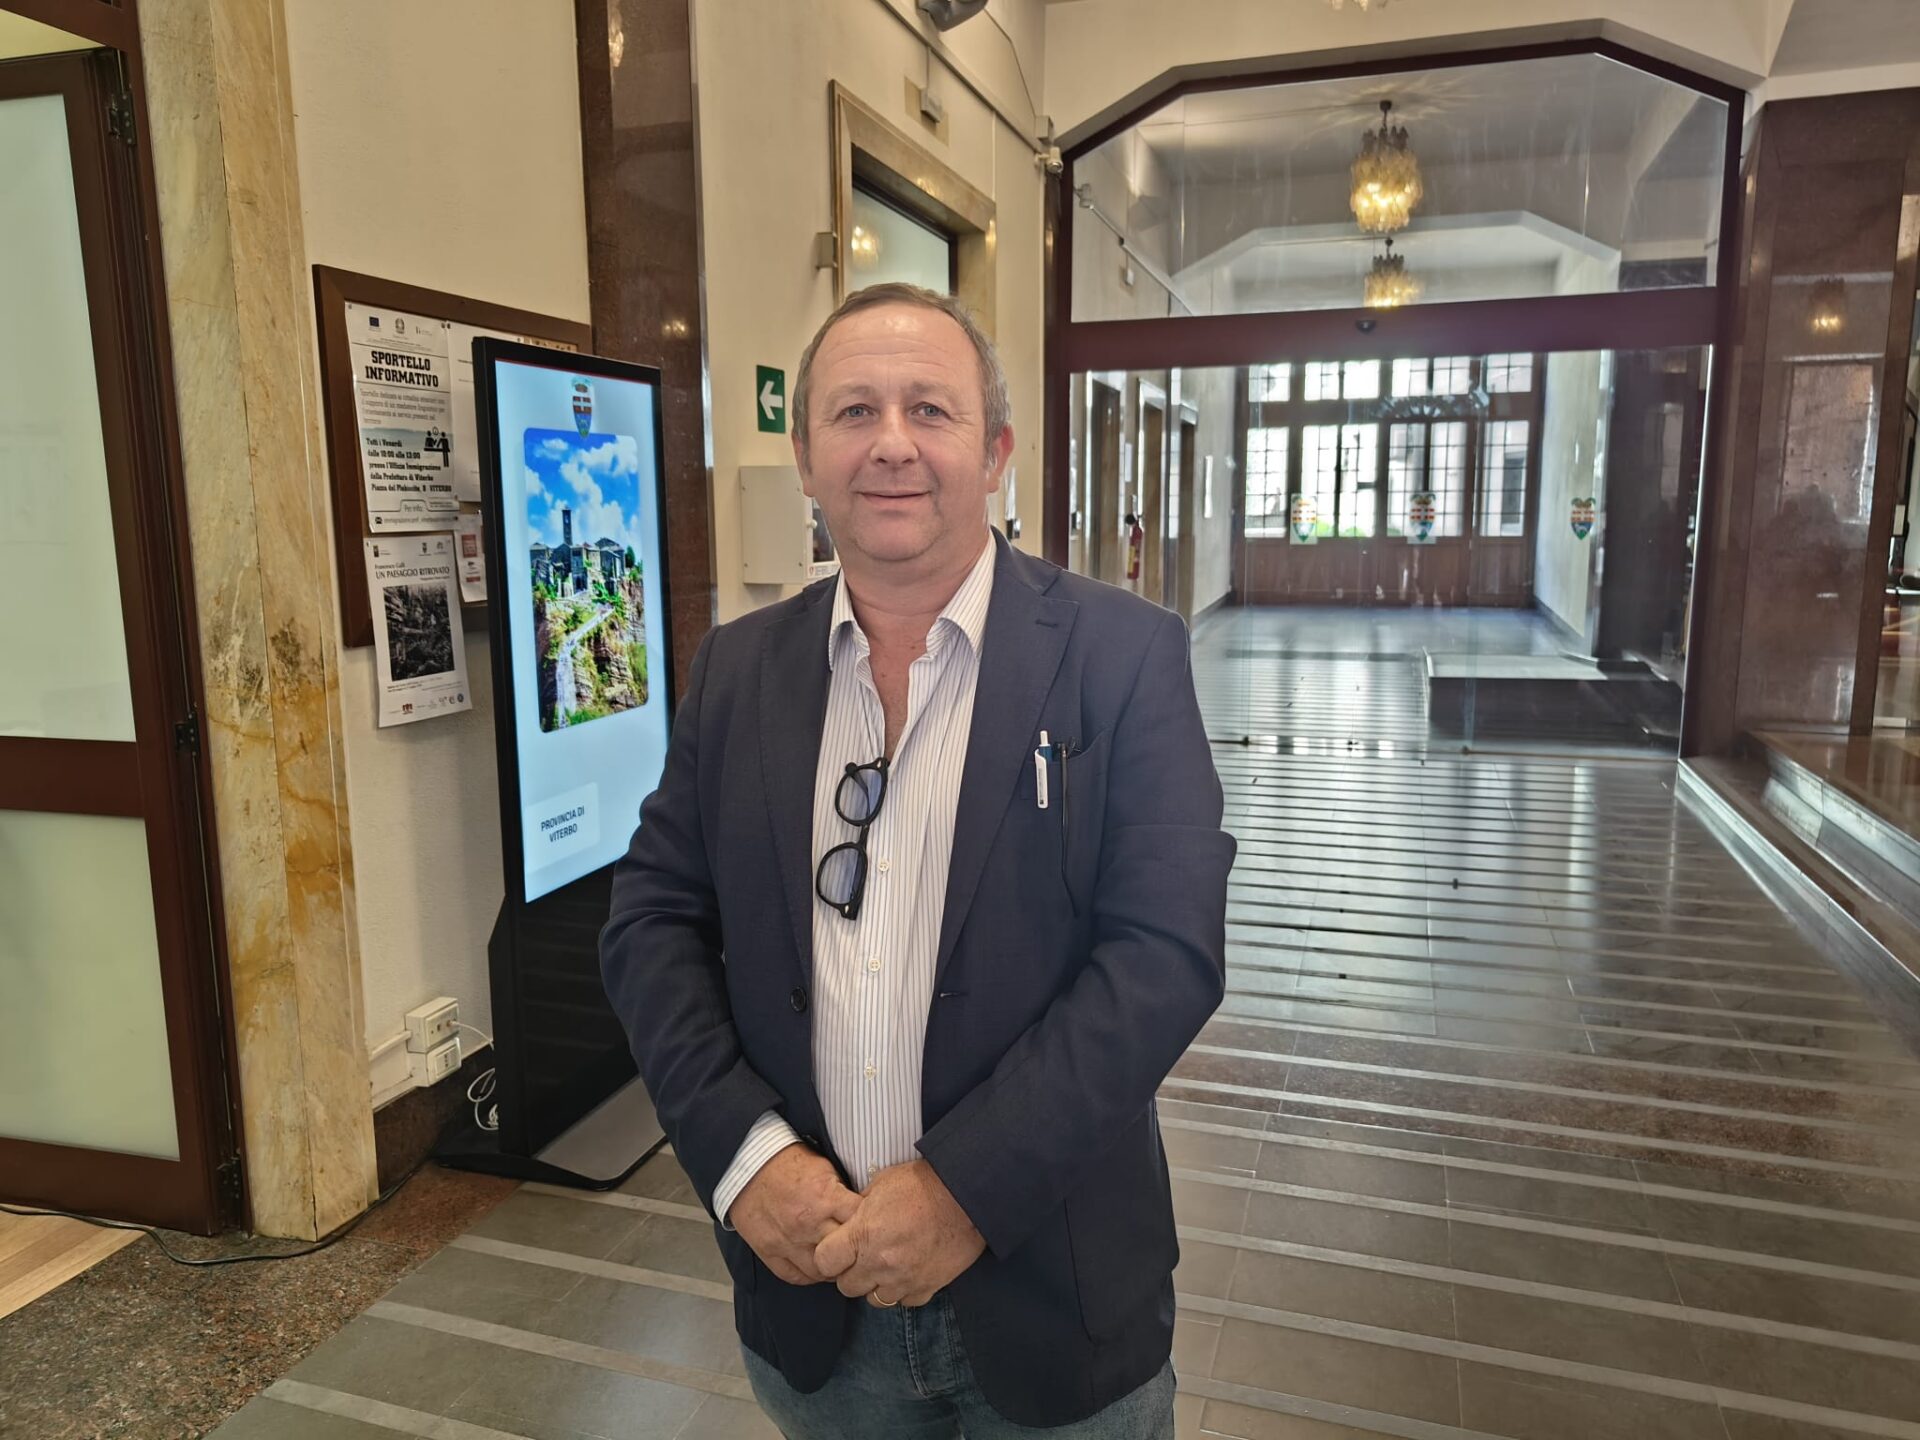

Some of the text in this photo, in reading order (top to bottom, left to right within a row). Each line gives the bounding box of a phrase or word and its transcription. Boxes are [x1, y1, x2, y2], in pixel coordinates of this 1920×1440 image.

[371, 350, 431, 371] SPORTELLO
[365, 365, 439, 388] INFORMATIVO
[414, 473, 434, 481] Viterbo
[375, 570, 386, 579] UN
[386, 568, 418, 578] PAESAGGIO
[419, 566, 450, 576] RITROVATO
[540, 805, 585, 832] PROVINCIA DI
[549, 823, 578, 843] VITERBO
